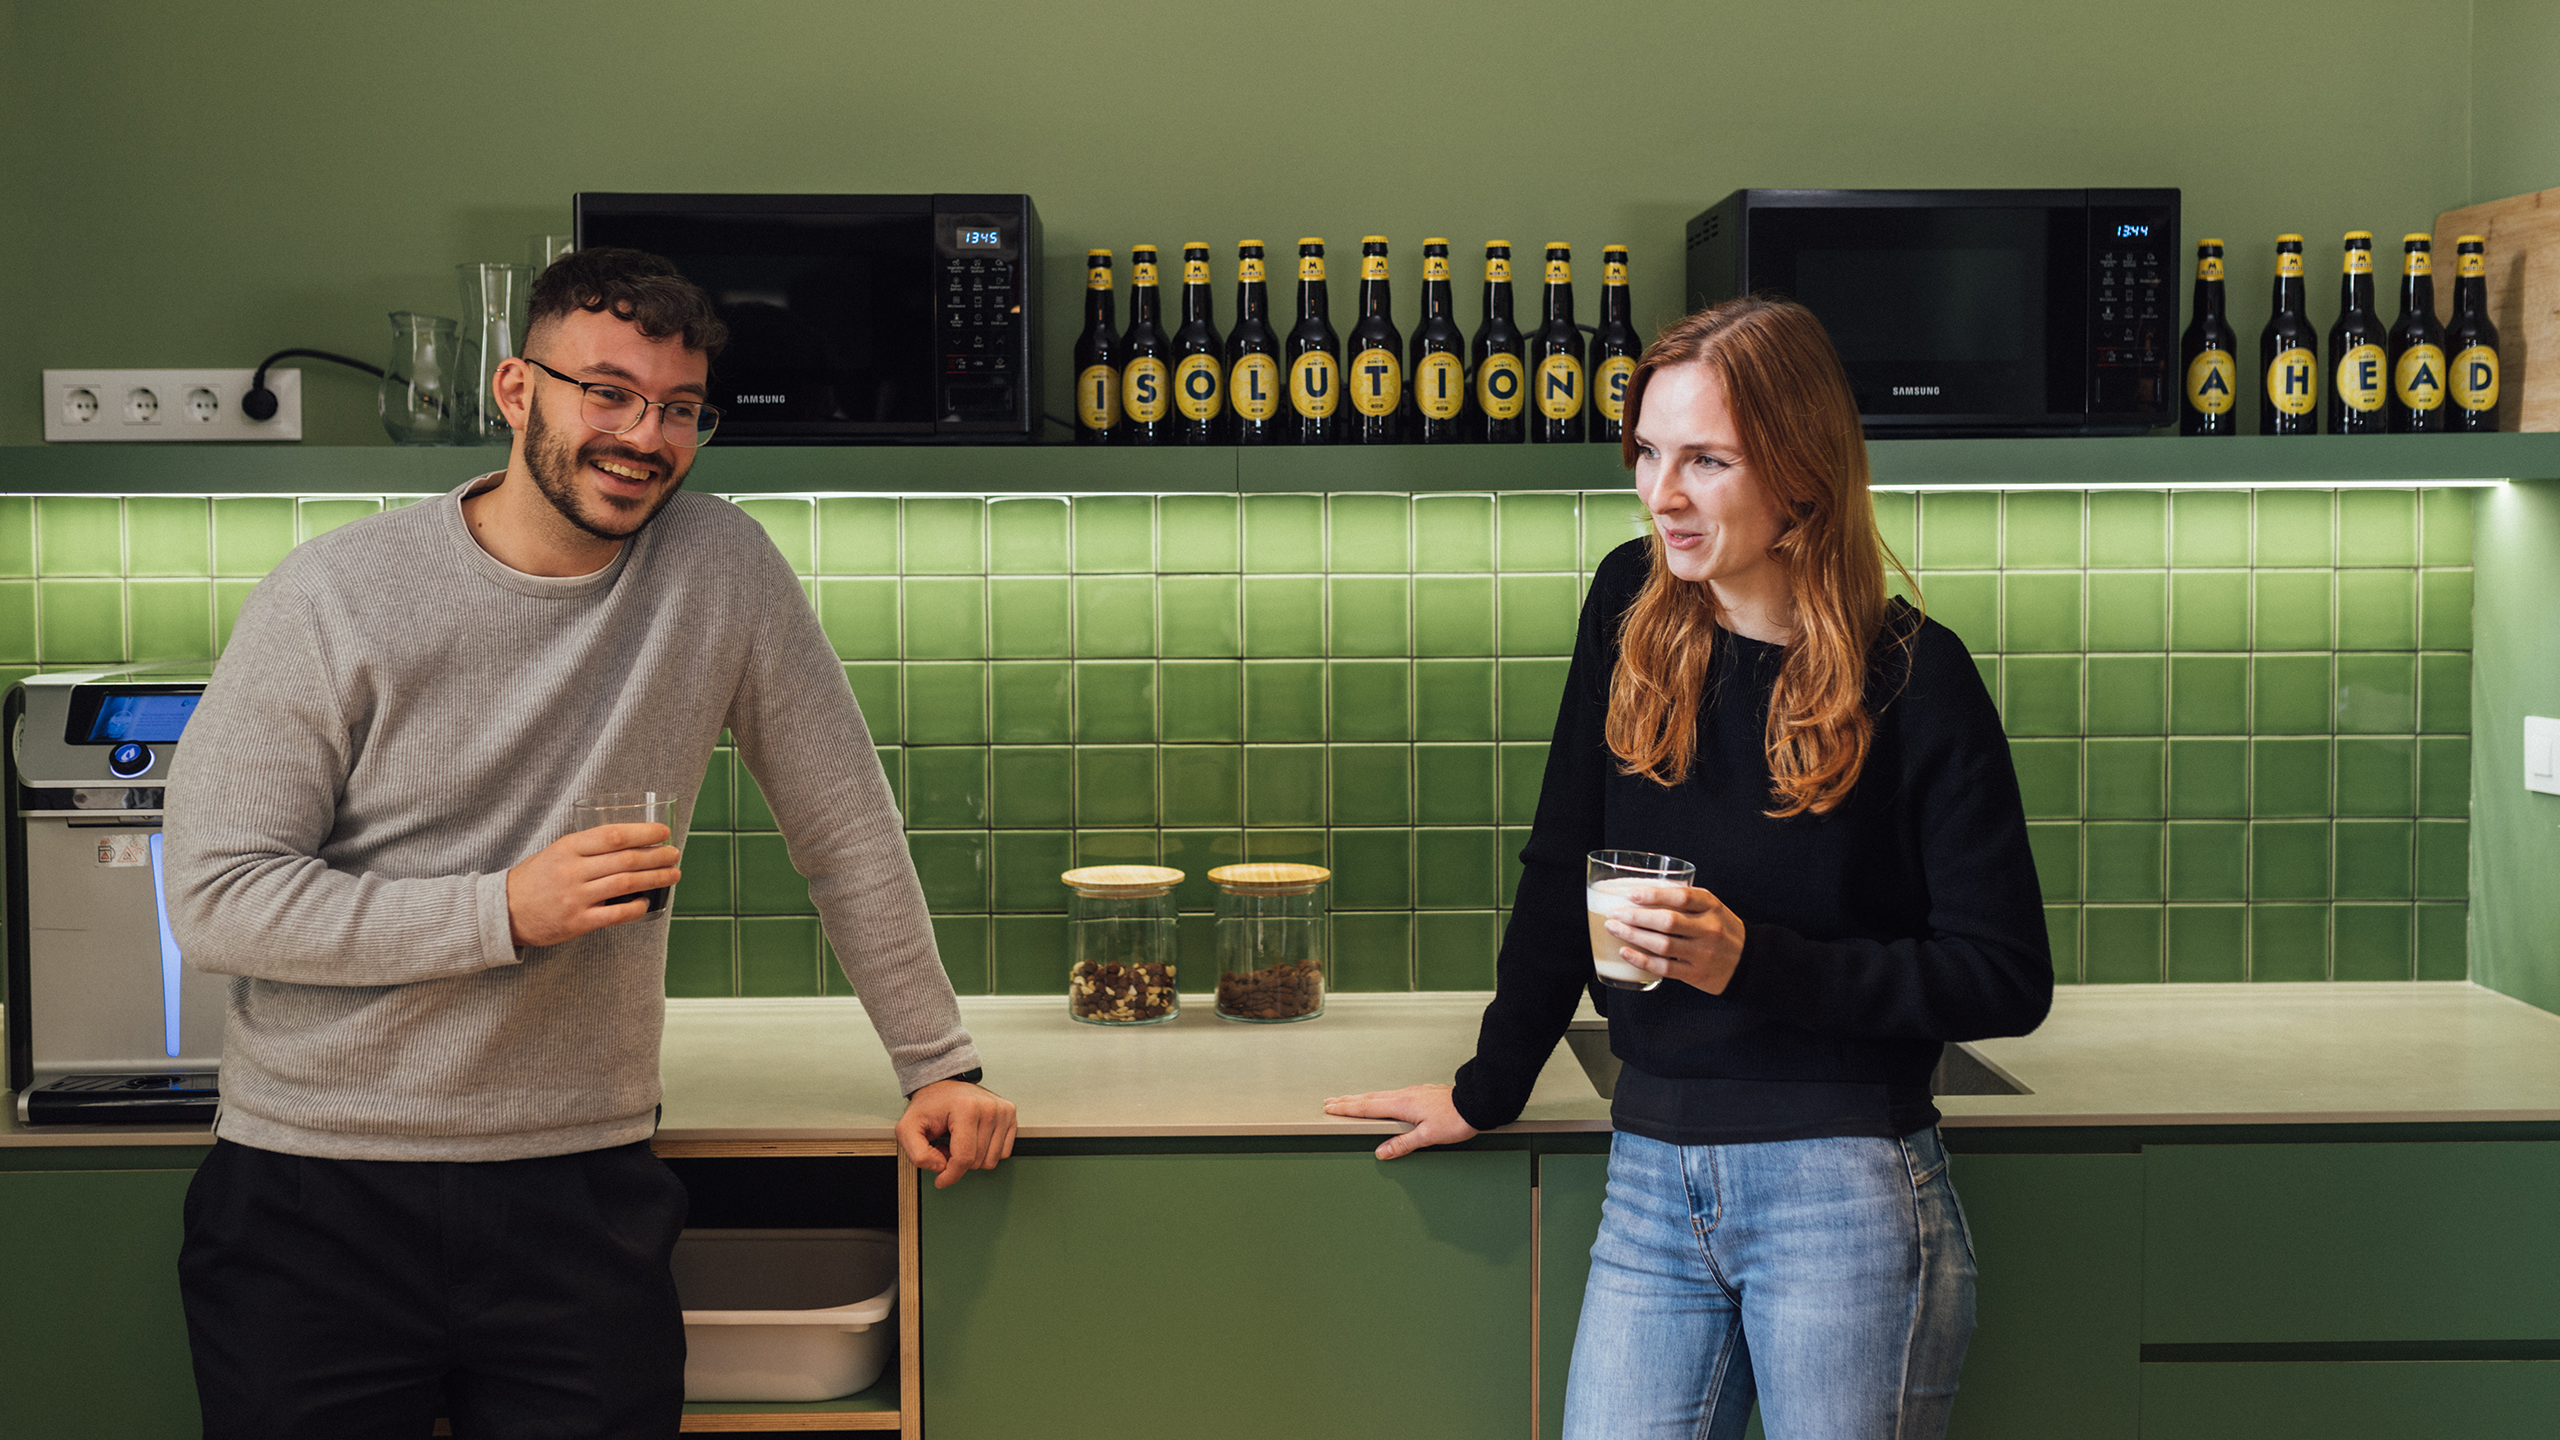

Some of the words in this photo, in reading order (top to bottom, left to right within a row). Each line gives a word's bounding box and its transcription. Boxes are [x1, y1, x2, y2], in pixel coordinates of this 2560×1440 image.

[1096, 380, 1105, 410] I
[1136, 373, 1157, 403] S
[1185, 369, 1216, 400] O
[1250, 370, 1266, 401] L
[1304, 367, 1328, 398] U
[1364, 365, 1388, 396] T
[1438, 368, 1446, 399] I
[1488, 368, 1518, 400] O
[1546, 371, 1574, 400] N
[1610, 372, 1629, 402] S
[2198, 366, 2229, 395] A
[2285, 365, 2309, 395] H
[2359, 361, 2377, 390] E
[2408, 361, 2439, 391] A
[2470, 362, 2492, 391] D
[736, 394, 786, 404] SAMSUNG
[1892, 386, 1940, 396] SAMSUNG
